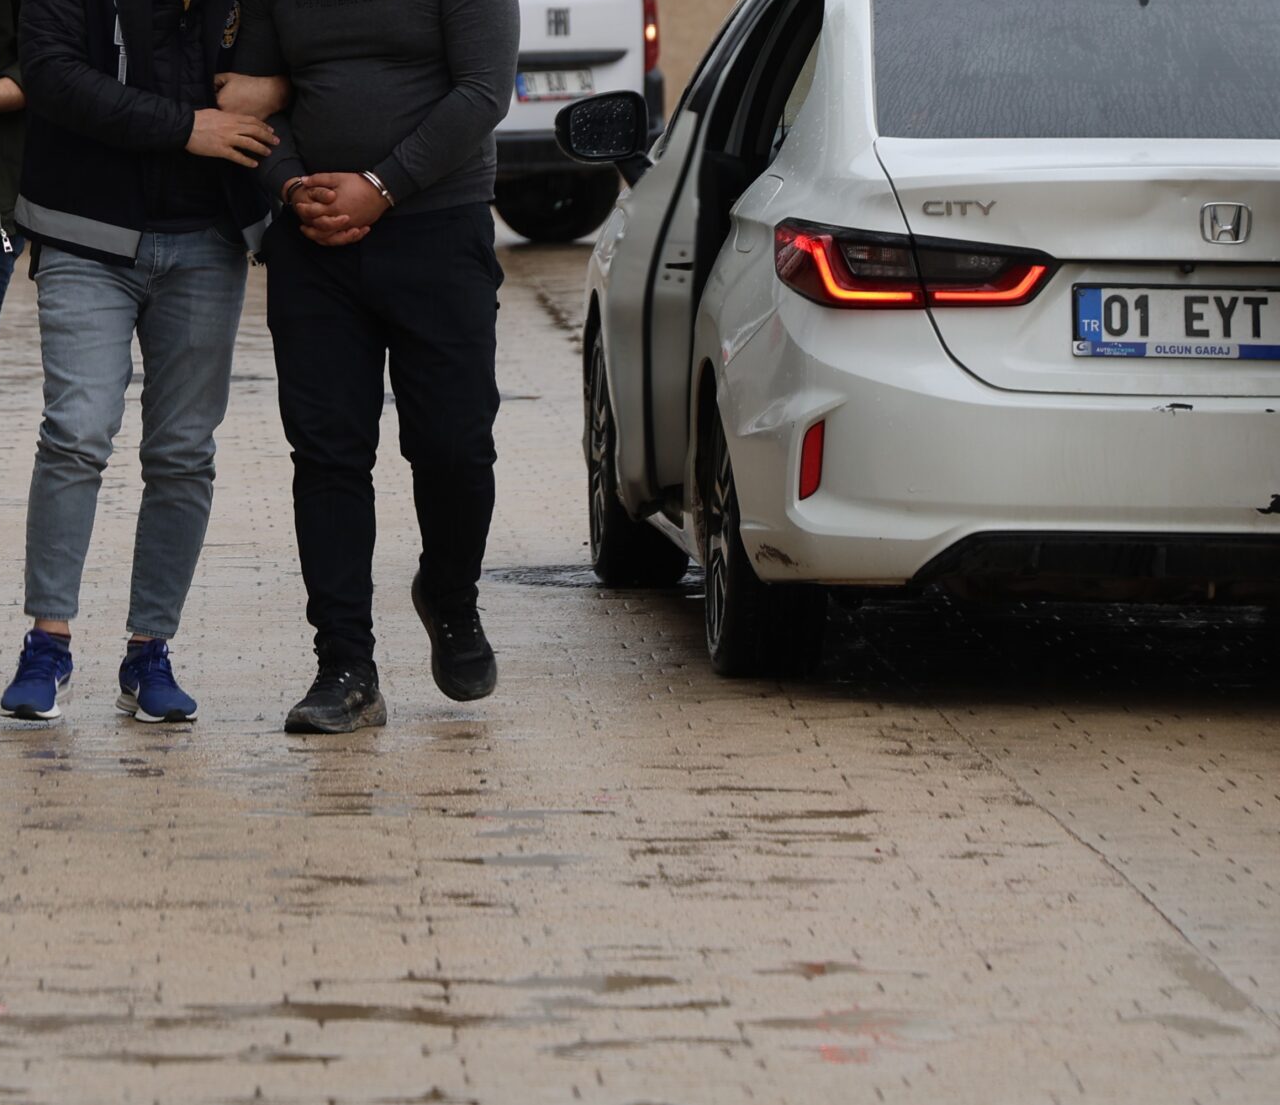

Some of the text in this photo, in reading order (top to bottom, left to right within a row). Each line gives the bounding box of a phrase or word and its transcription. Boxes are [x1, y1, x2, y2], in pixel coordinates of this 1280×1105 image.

[922, 199, 997, 216] CITY
[1104, 295, 1269, 338] 01 EYT
[1082, 320, 1100, 332] TR
[1155, 345, 1231, 356] OLGUN GARAJ
